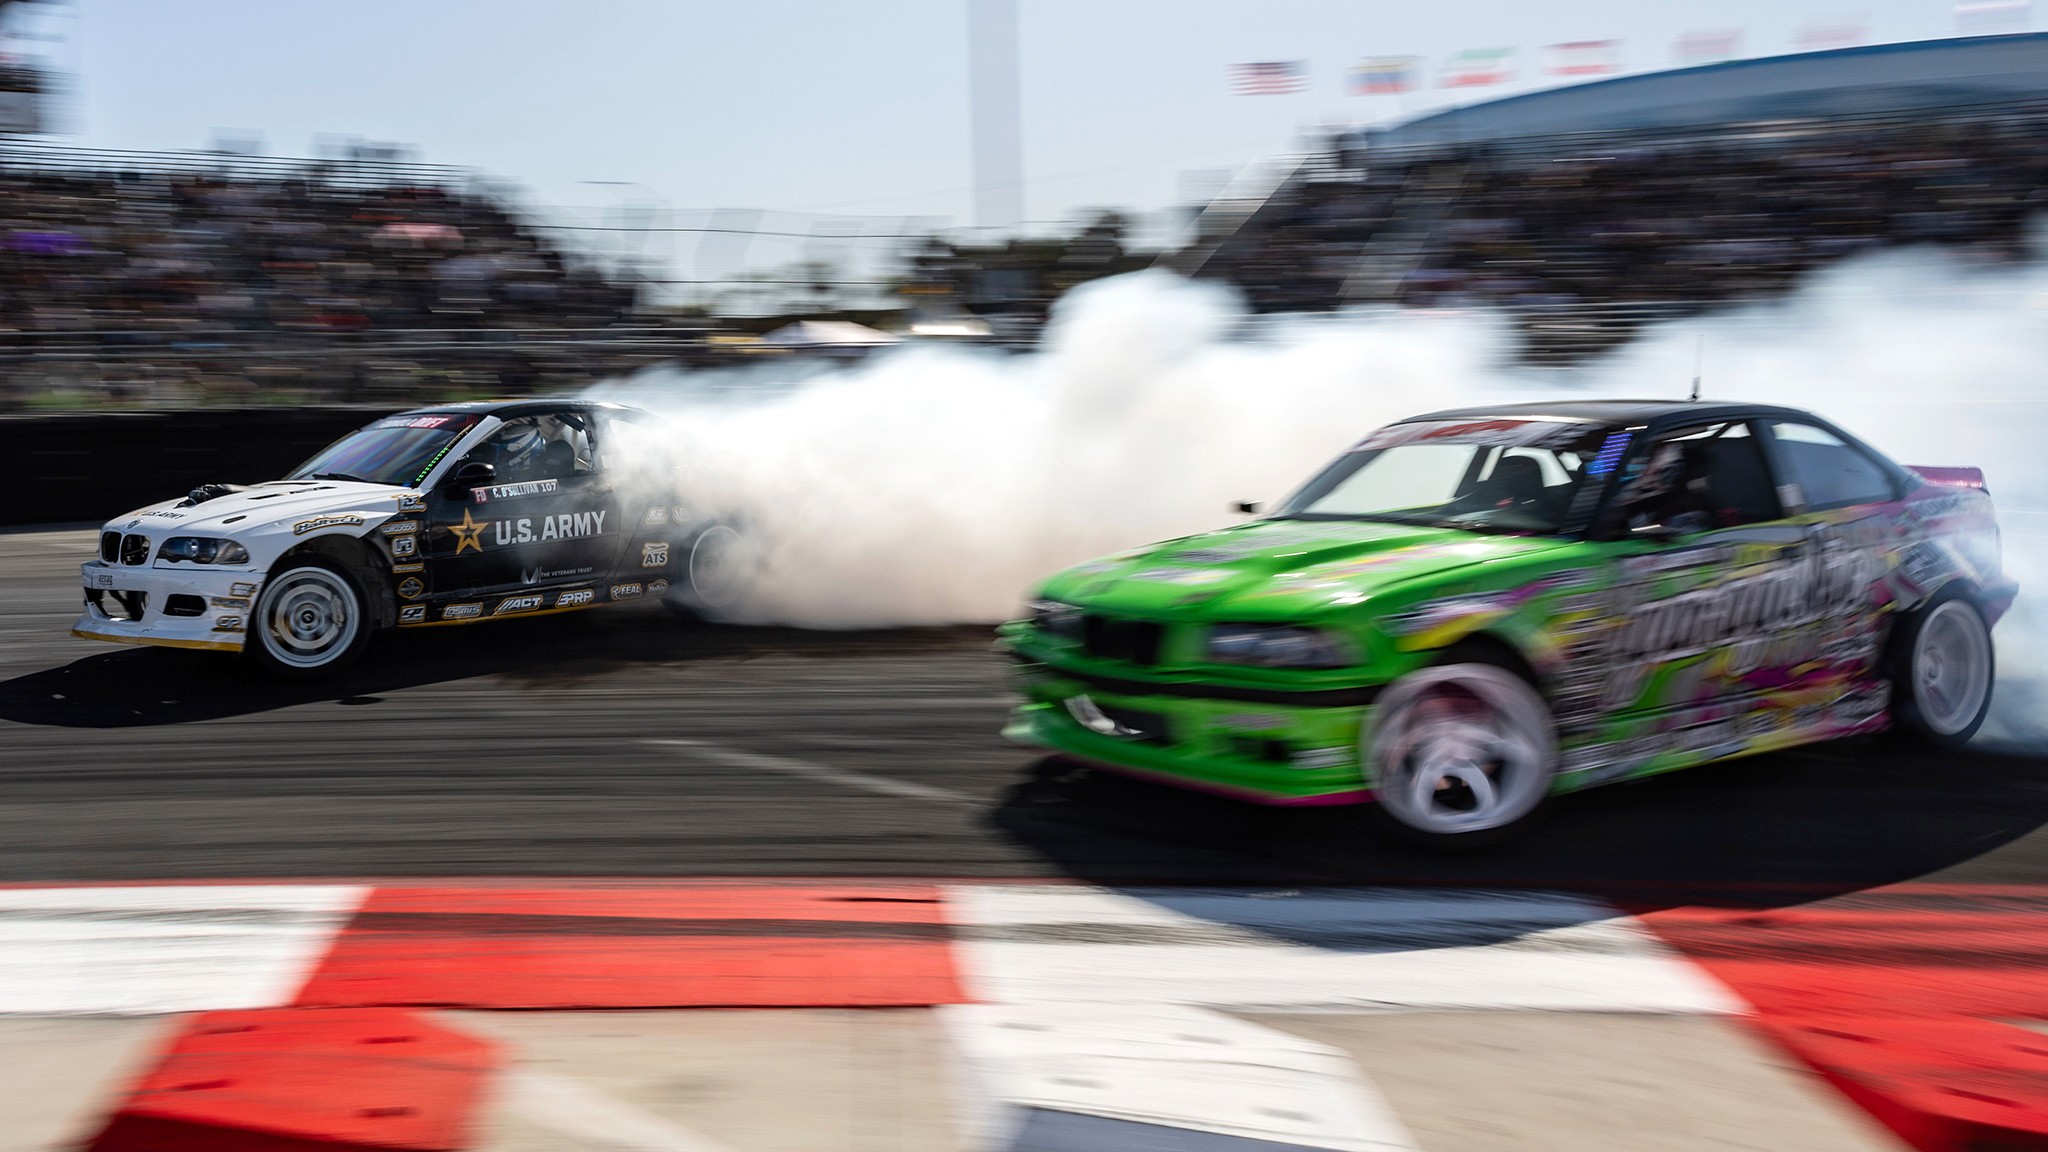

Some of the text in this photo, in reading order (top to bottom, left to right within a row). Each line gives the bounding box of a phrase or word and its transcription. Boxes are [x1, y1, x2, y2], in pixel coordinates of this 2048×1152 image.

[475, 483, 557, 502] FD C. O'SULLIVAN 107
[297, 517, 362, 533] Haltech
[496, 510, 606, 545] U.S. ARMY
[645, 552, 666, 564] ATS
[621, 585, 641, 595] FEAL
[558, 591, 593, 605] PRP
